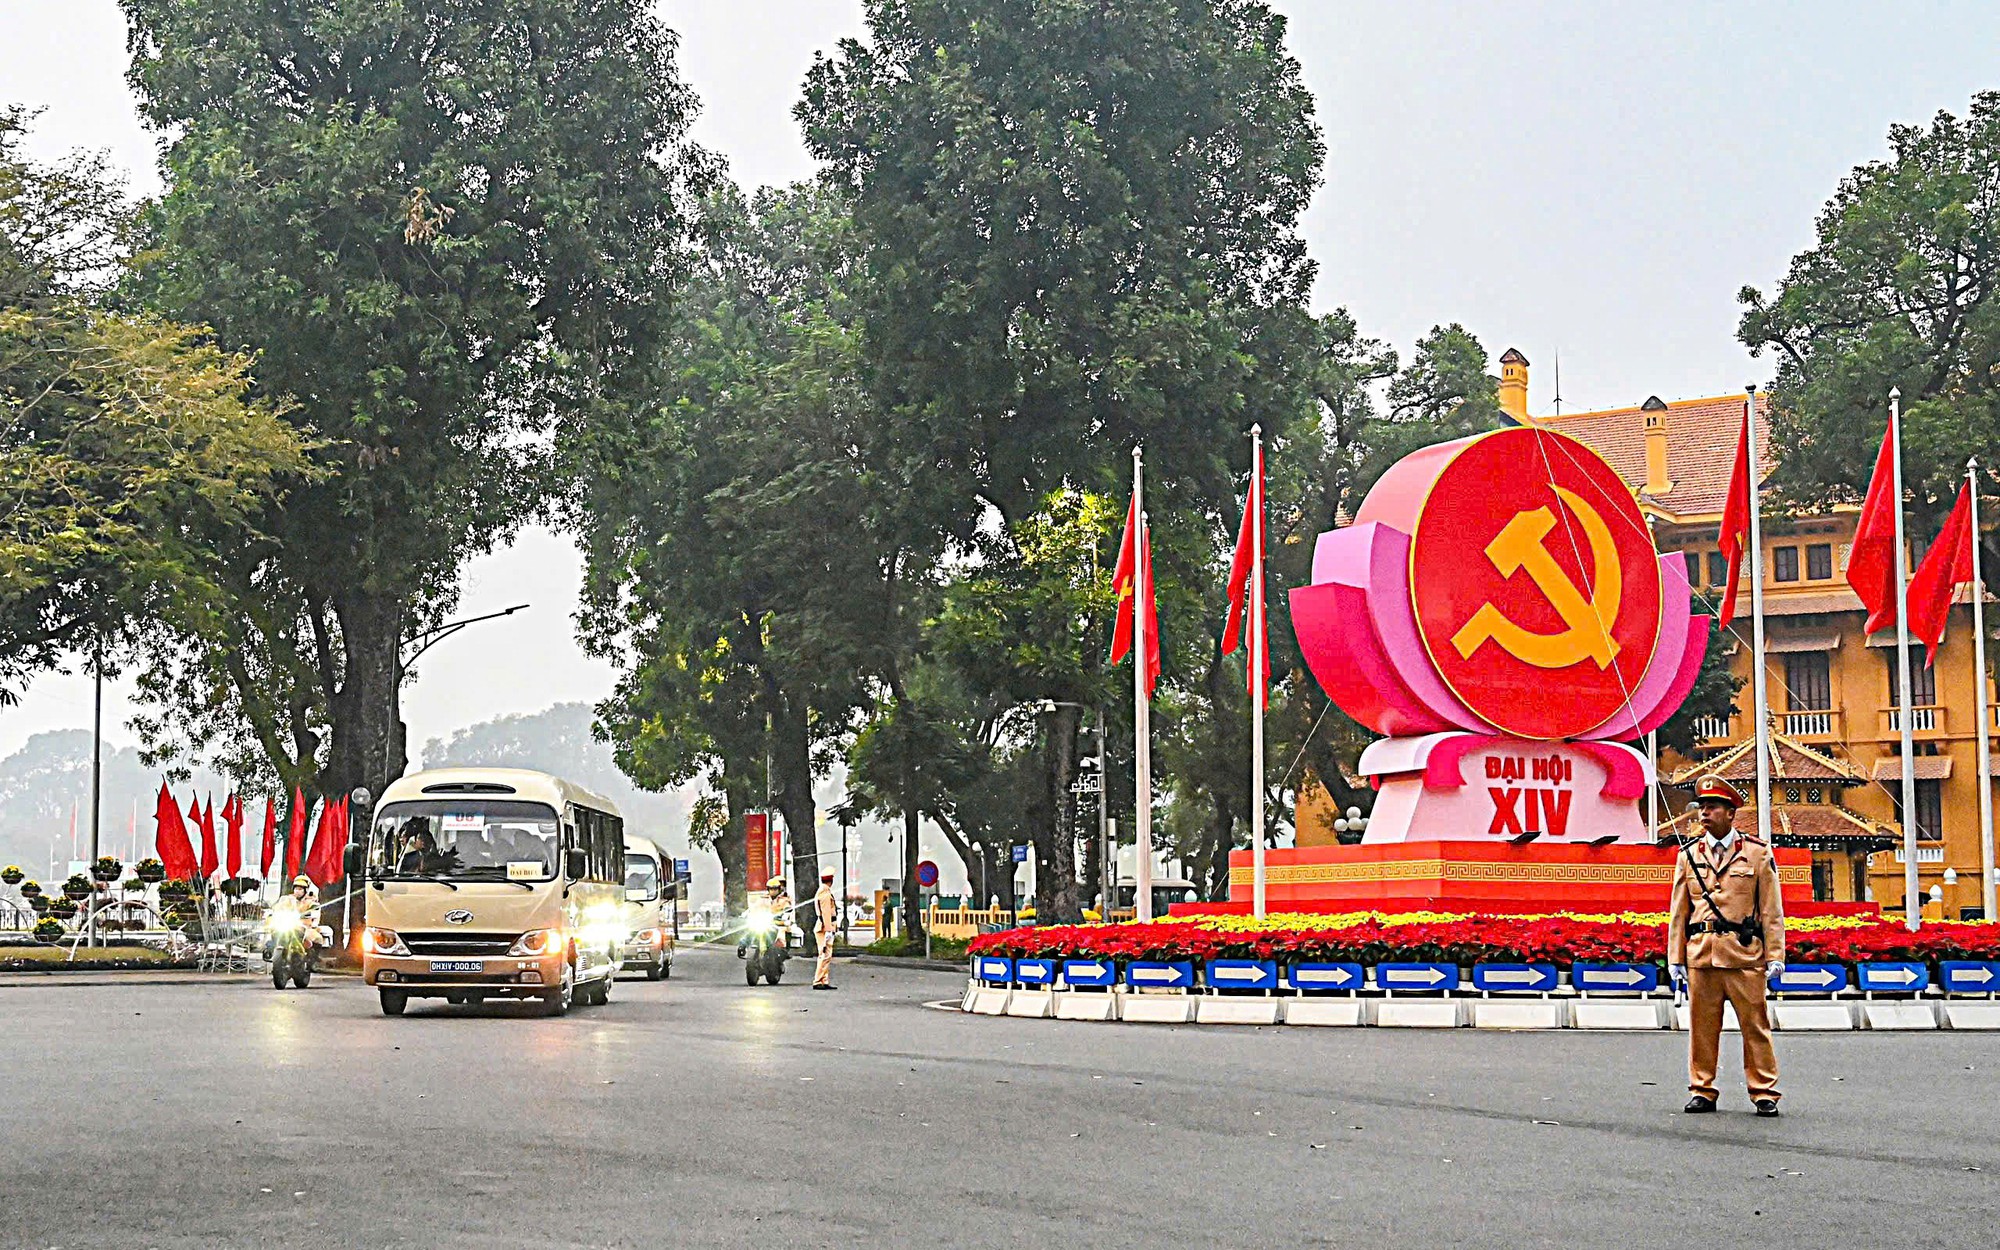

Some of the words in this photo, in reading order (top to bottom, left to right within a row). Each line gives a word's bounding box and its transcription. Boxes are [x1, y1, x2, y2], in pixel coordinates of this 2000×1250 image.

[1485, 756, 1525, 784] ĐẠI
[1532, 754, 1572, 786] HỘI
[1488, 787, 1572, 836] XIV
